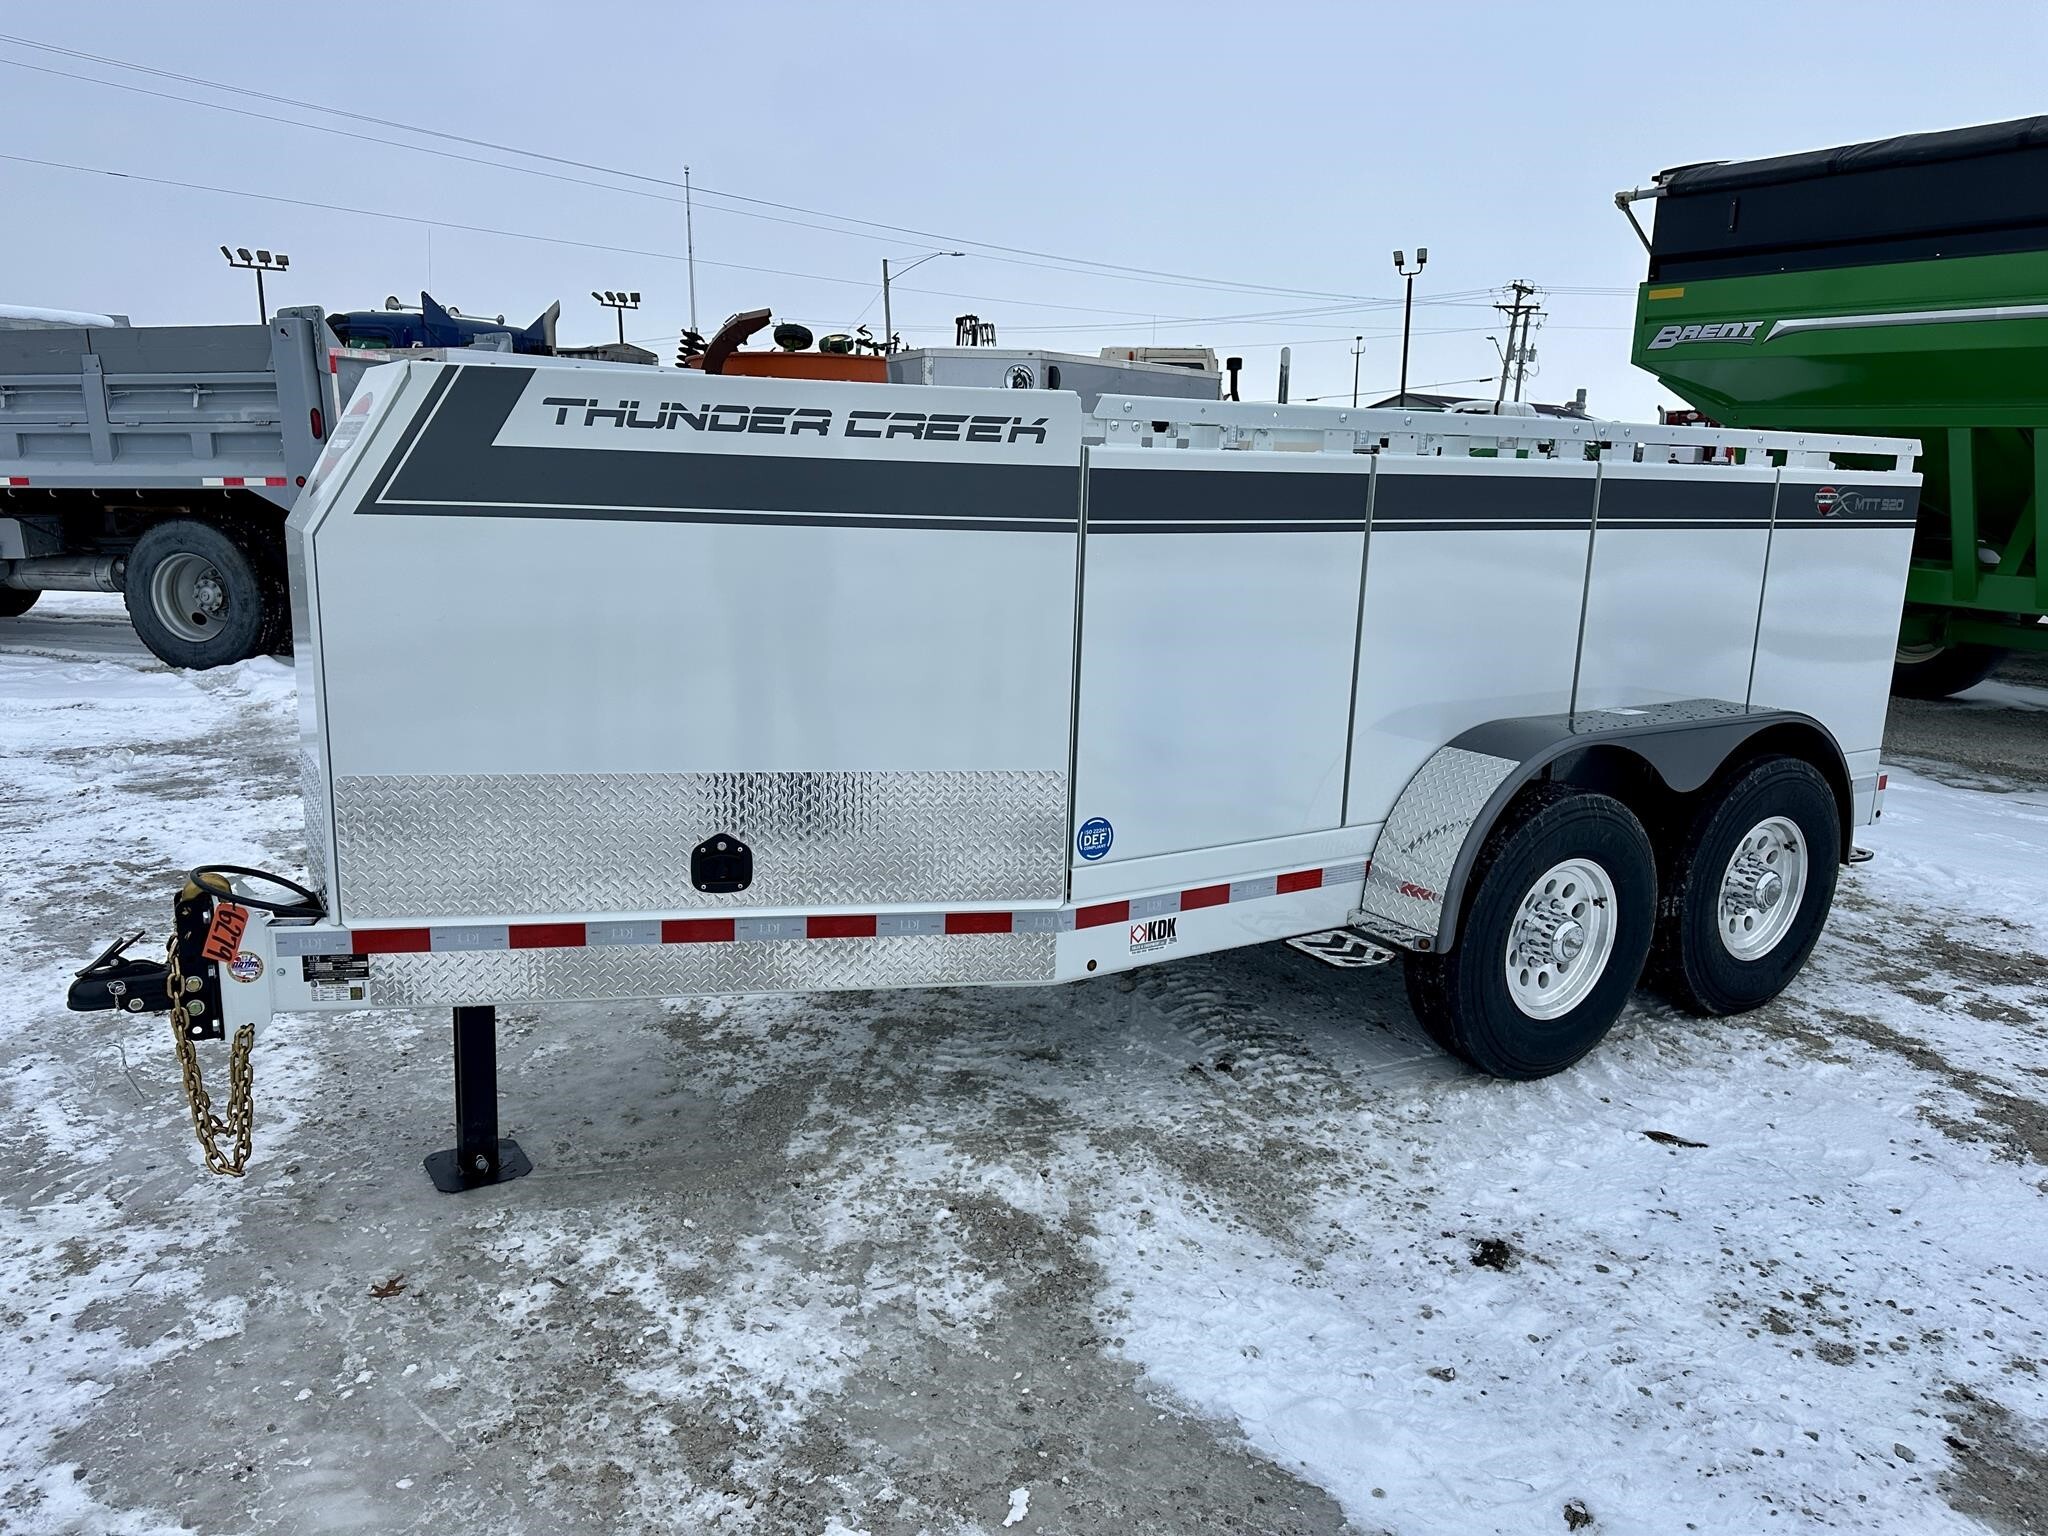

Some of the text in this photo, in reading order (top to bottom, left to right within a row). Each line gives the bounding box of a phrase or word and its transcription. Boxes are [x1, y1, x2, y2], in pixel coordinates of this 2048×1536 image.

[1647, 321, 1764, 350] BRENT
[543, 396, 1050, 445] THUNDER CREEK
[1854, 498, 1905, 511] MTT 920
[1084, 833, 1107, 846] DEF
[1147, 917, 1177, 942] KDK
